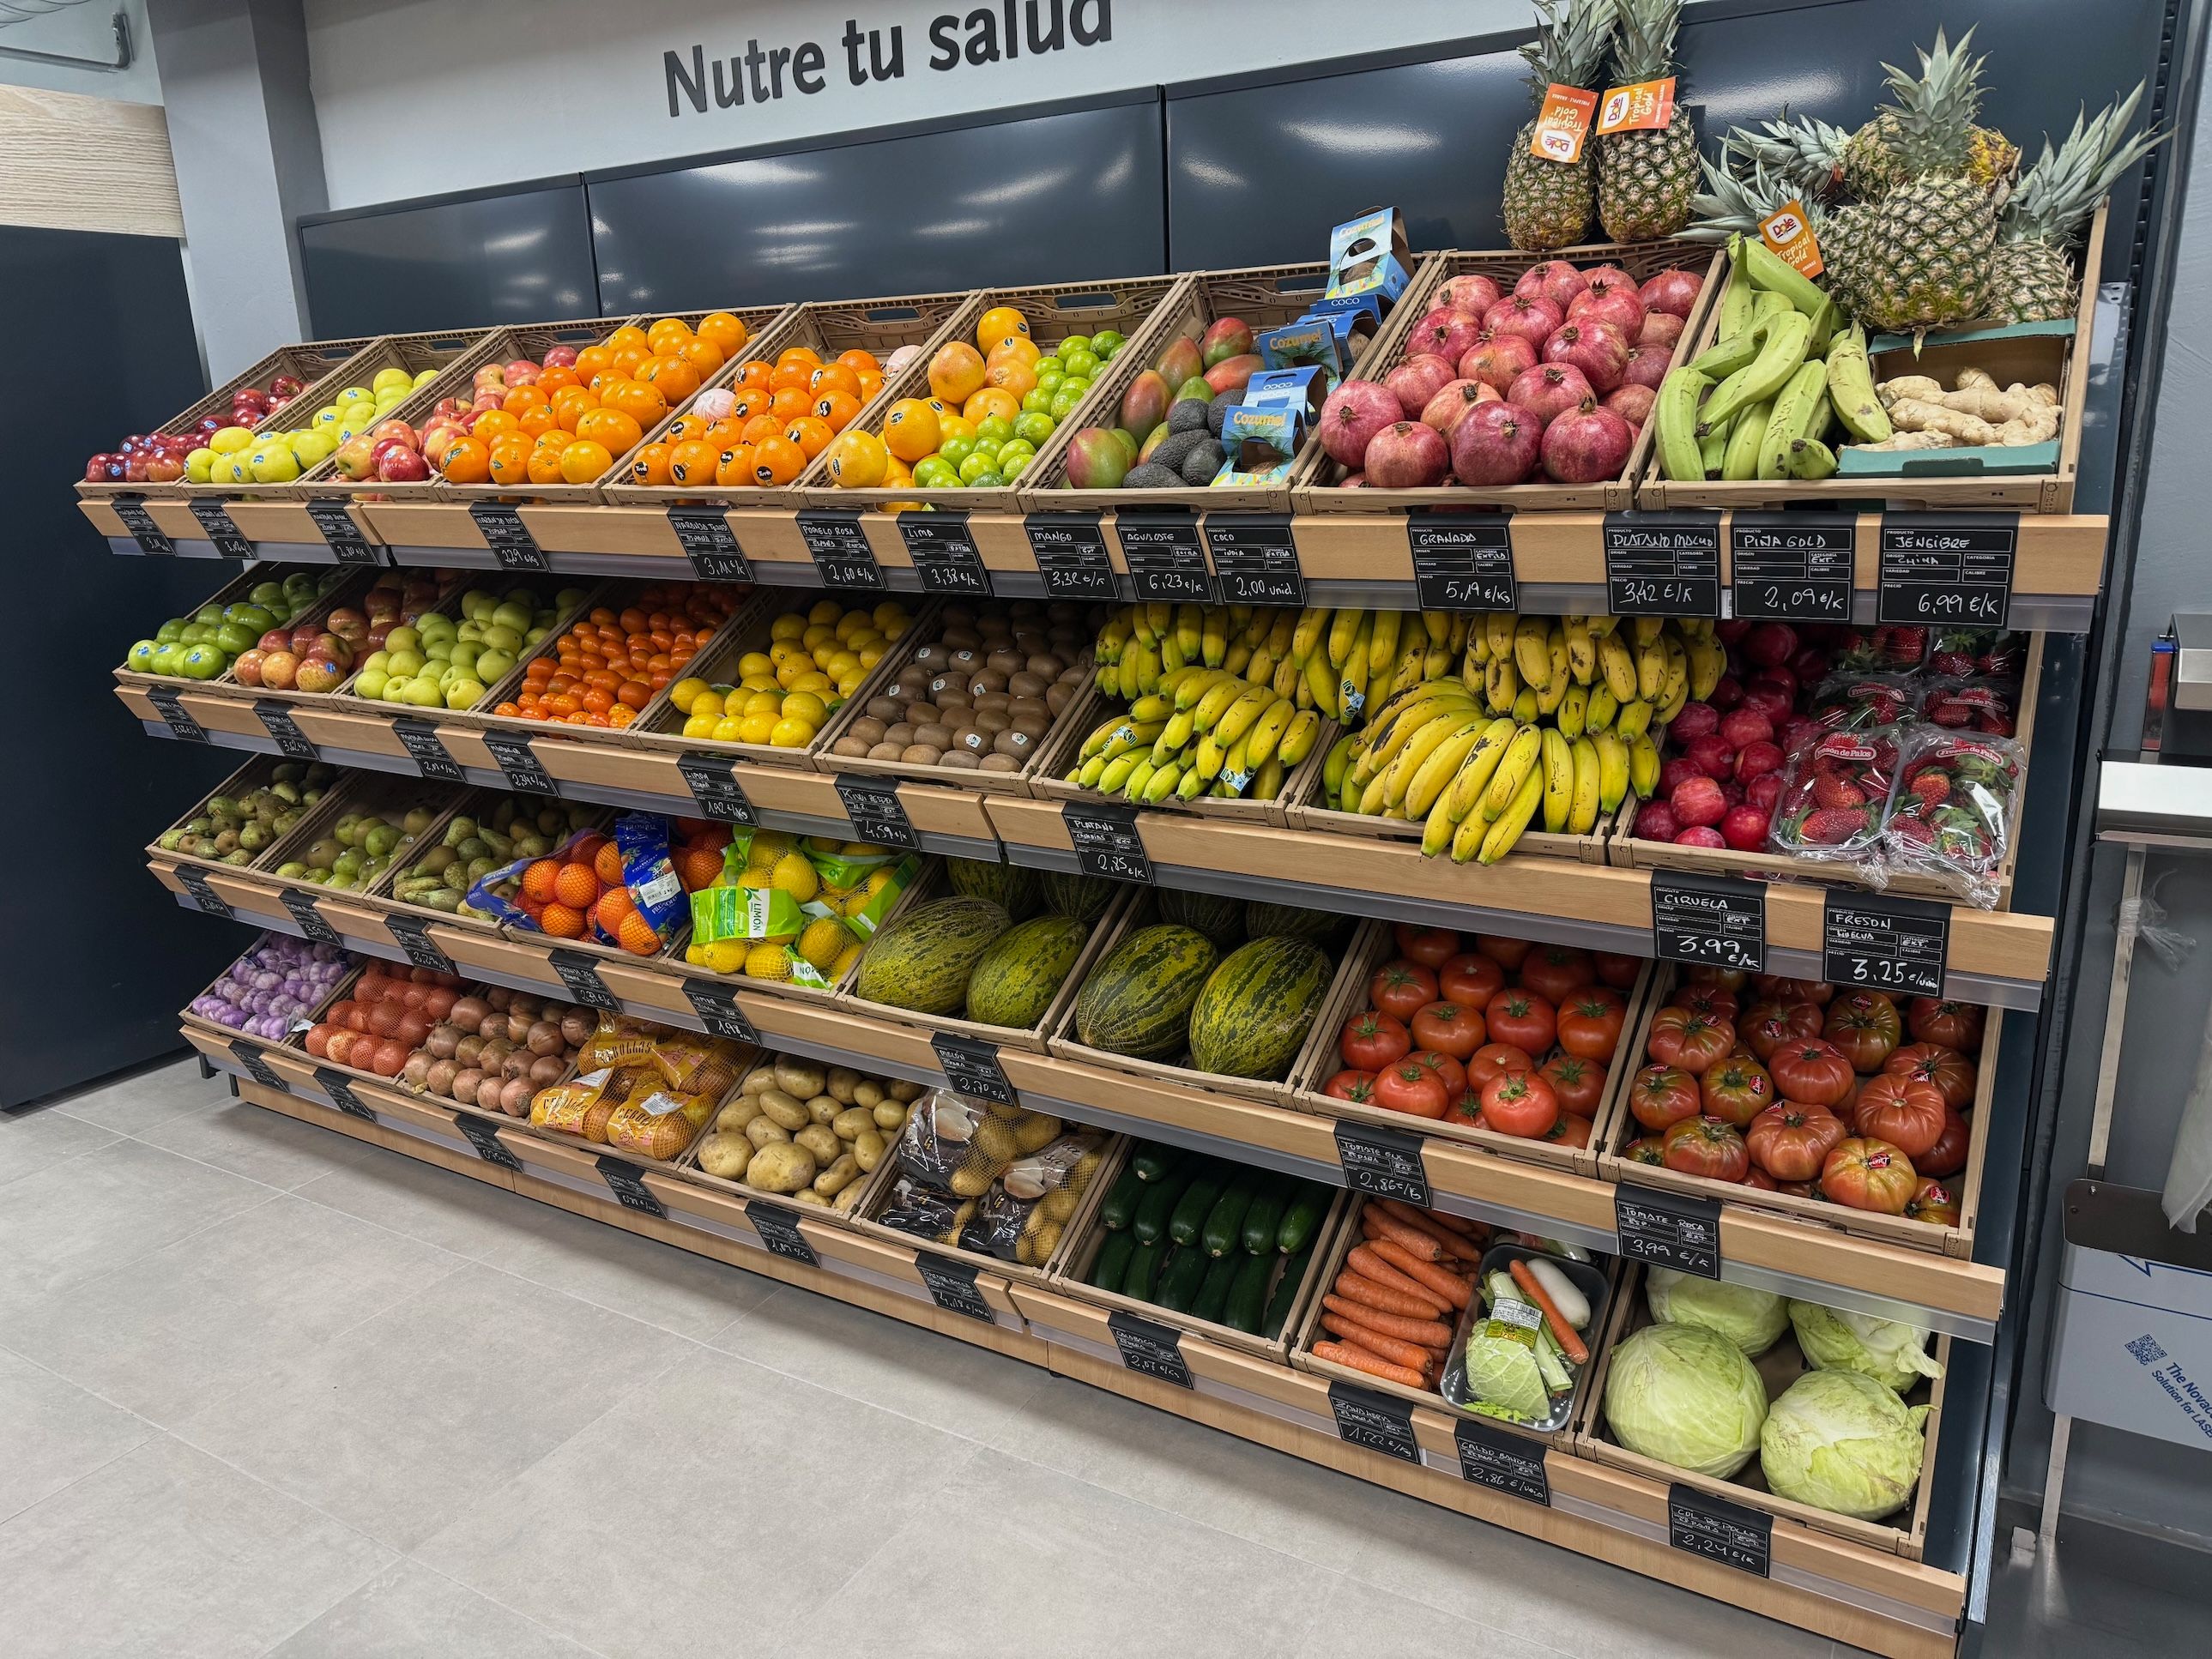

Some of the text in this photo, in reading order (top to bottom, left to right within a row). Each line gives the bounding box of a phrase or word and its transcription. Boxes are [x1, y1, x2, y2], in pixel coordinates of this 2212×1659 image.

[664, 0, 1113, 117] Nutre tu salud
[1556, 106, 1578, 118] Gold
[1608, 97, 1623, 121] Dole
[1629, 87, 1643, 124] Tropical
[1641, 93, 1653, 115] Gold
[1545, 115, 1582, 132] Tropical
[1545, 136, 1569, 152] Dole
[1339, 213, 1385, 237] Cozumel
[1772, 218, 1796, 238] Dole
[1776, 232, 1810, 260] Tropical
[1269, 329, 1323, 351] Cozumel
[1233, 411, 1288, 427] Cozumel
[835, 527, 855, 535] ROSA
[908, 528, 934, 538] LIMA
[1034, 531, 1073, 542] MANGO
[1213, 534, 1235, 542] COCO
[1419, 532, 1477, 545] GRANADA
[1786, 534, 1826, 548] GOLD
[931, 568, 958, 586] 3,38
[1149, 574, 1183, 590] 6,23
[1236, 576, 1266, 596] 2,00
[1619, 580, 1659, 605] 3,42
[1765, 586, 1816, 612] 2,09
[1918, 594, 1963, 614] 6,99
[1850, 749, 1871, 757] Palos
[866, 820, 893, 839] 4,59
[1073, 820, 1114, 831] PLATANO
[1098, 854, 1127, 872] 2,85
[1665, 894, 1728, 909] CIRUELA
[752, 903, 763, 932] LIMÓN
[1835, 914, 1891, 930] FRESON
[1623, 1205, 1706, 1231] TOMATE ROSA
[2166, 1362, 2186, 1384] The
[2152, 1370, 2184, 1403] Solution
[2180, 1402, 2195, 1415] for
[1677, 1509, 1698, 1519] COL
